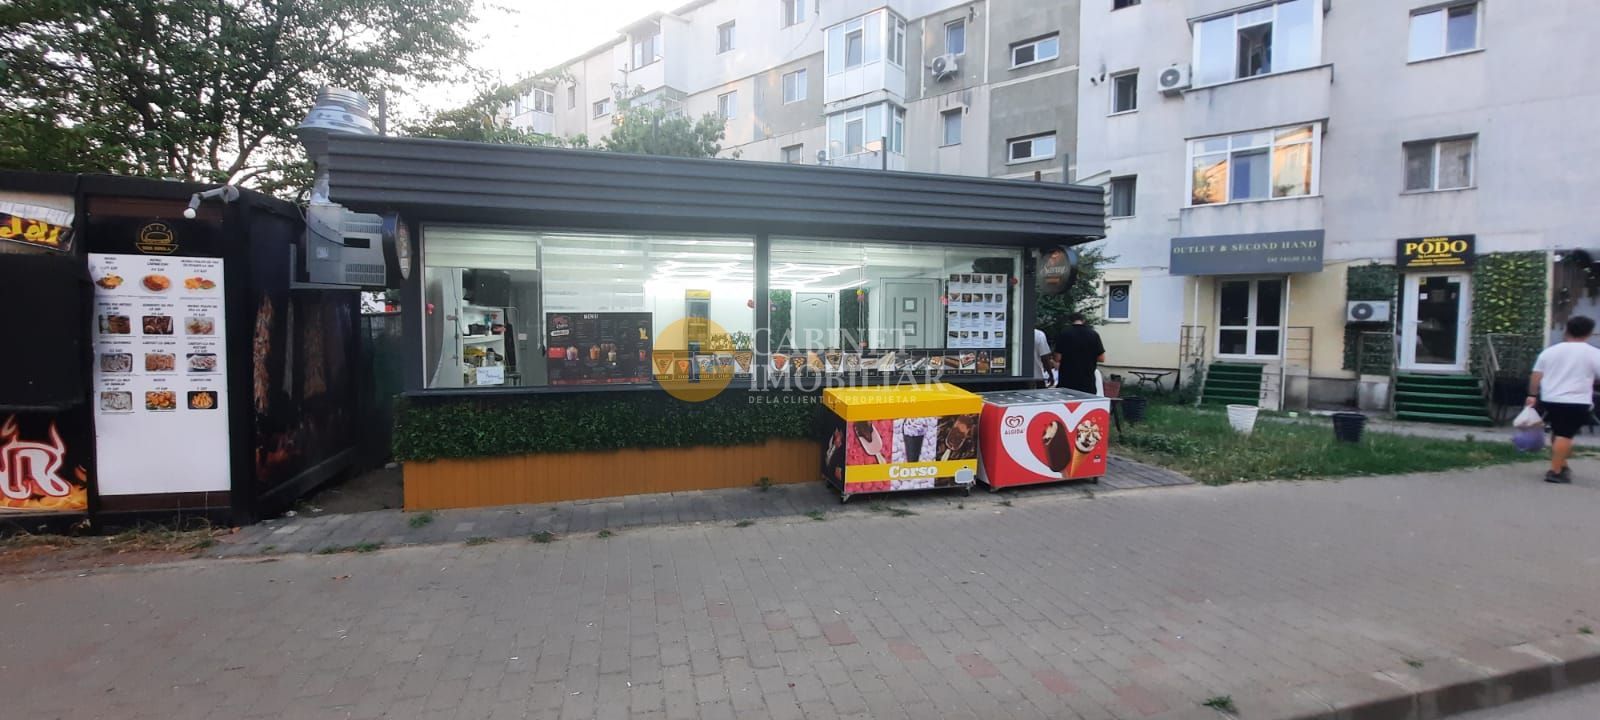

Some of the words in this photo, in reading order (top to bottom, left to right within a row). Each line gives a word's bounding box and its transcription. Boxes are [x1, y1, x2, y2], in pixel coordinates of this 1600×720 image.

[1173, 244, 1215, 254] OUTLET
[1219, 244, 1228, 252] &
[1231, 242, 1278, 252] SECOND
[1281, 240, 1318, 249] HAND
[1404, 240, 1468, 256] PODO
[888, 465, 938, 478] Corso
